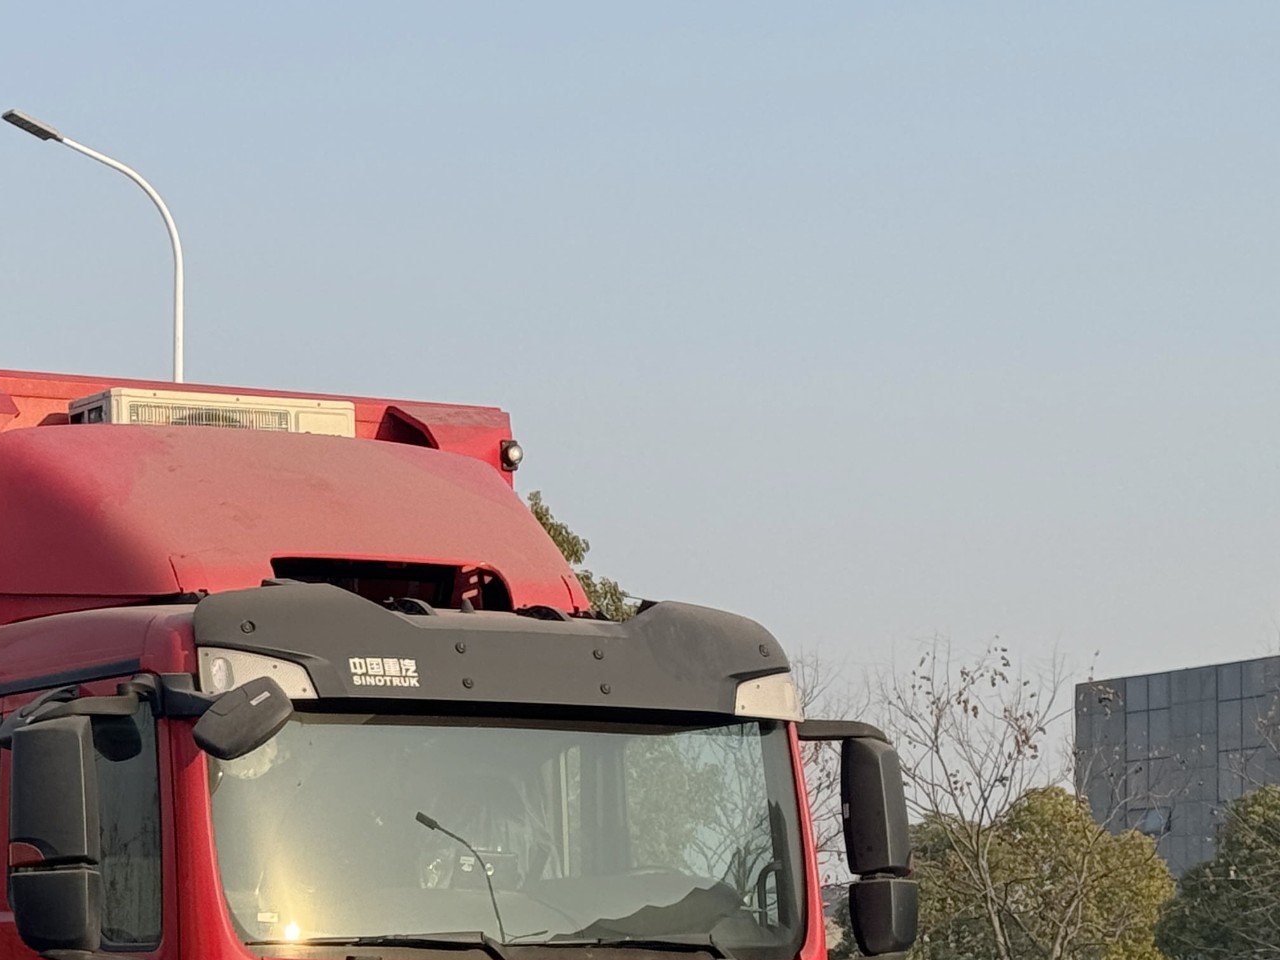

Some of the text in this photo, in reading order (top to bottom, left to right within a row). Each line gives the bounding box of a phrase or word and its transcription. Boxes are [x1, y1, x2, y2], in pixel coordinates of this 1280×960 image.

[348, 657, 418, 676] 中国重汽
[352, 675, 420, 687] SINOTRUK
